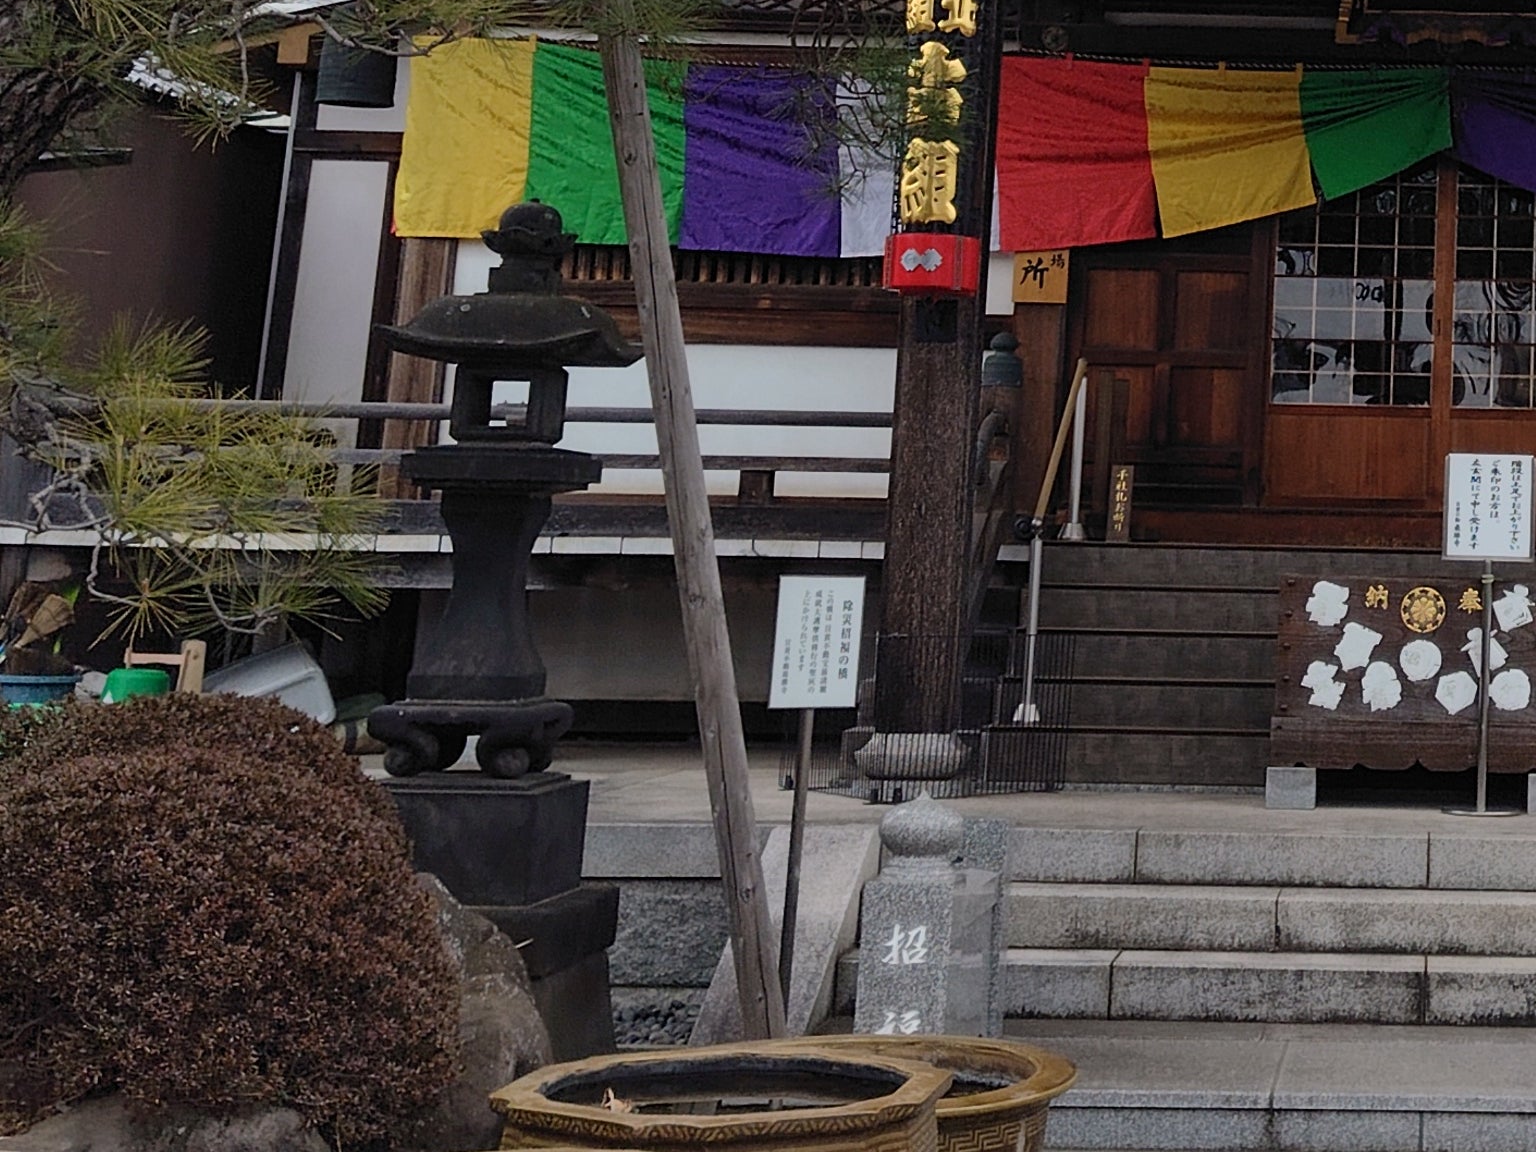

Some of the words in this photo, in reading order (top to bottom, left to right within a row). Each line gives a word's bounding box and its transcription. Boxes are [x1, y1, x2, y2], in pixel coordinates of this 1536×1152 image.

[1020, 258, 1049, 289] 所
[1364, 584, 1389, 610] 納
[1458, 587, 1483, 614] 奉
